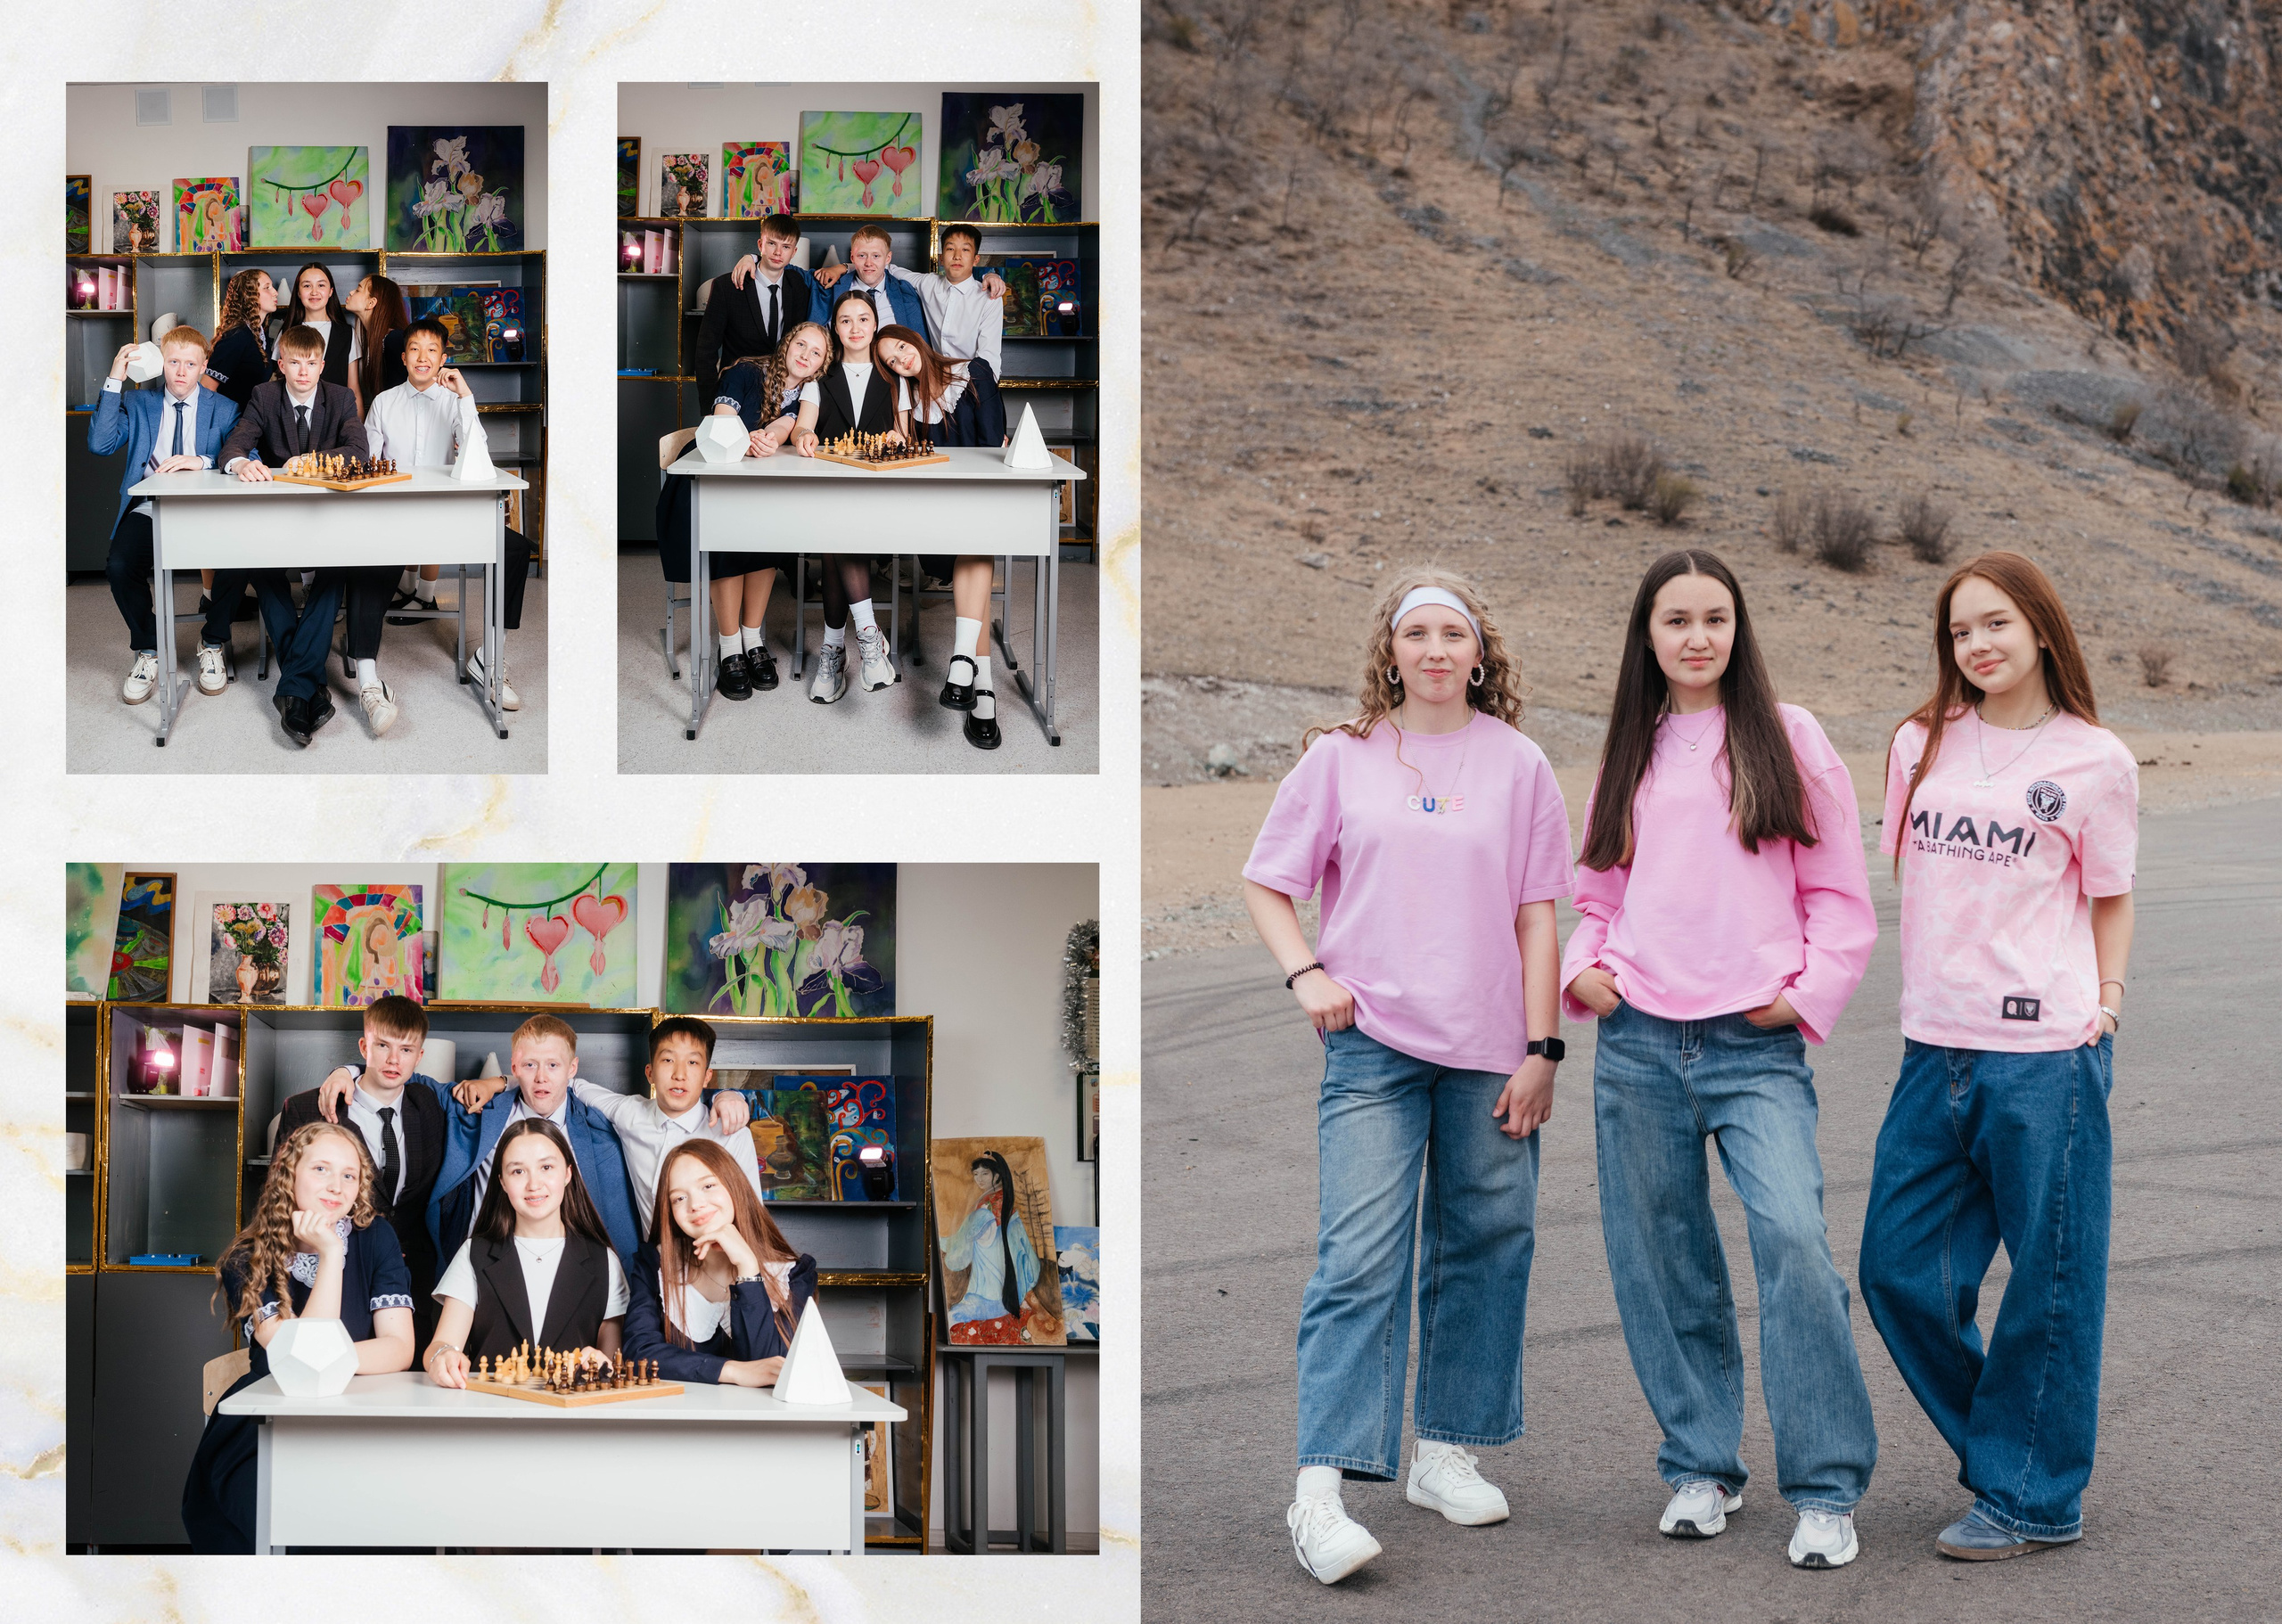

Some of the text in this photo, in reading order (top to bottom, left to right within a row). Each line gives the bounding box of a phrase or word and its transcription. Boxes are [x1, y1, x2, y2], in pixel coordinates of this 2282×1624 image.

[1407, 795, 1464, 812] CUTE
[1910, 810, 2036, 857] MIAMI
[1917, 840, 1925, 852] A
[1926, 841, 1985, 861] BATHING
